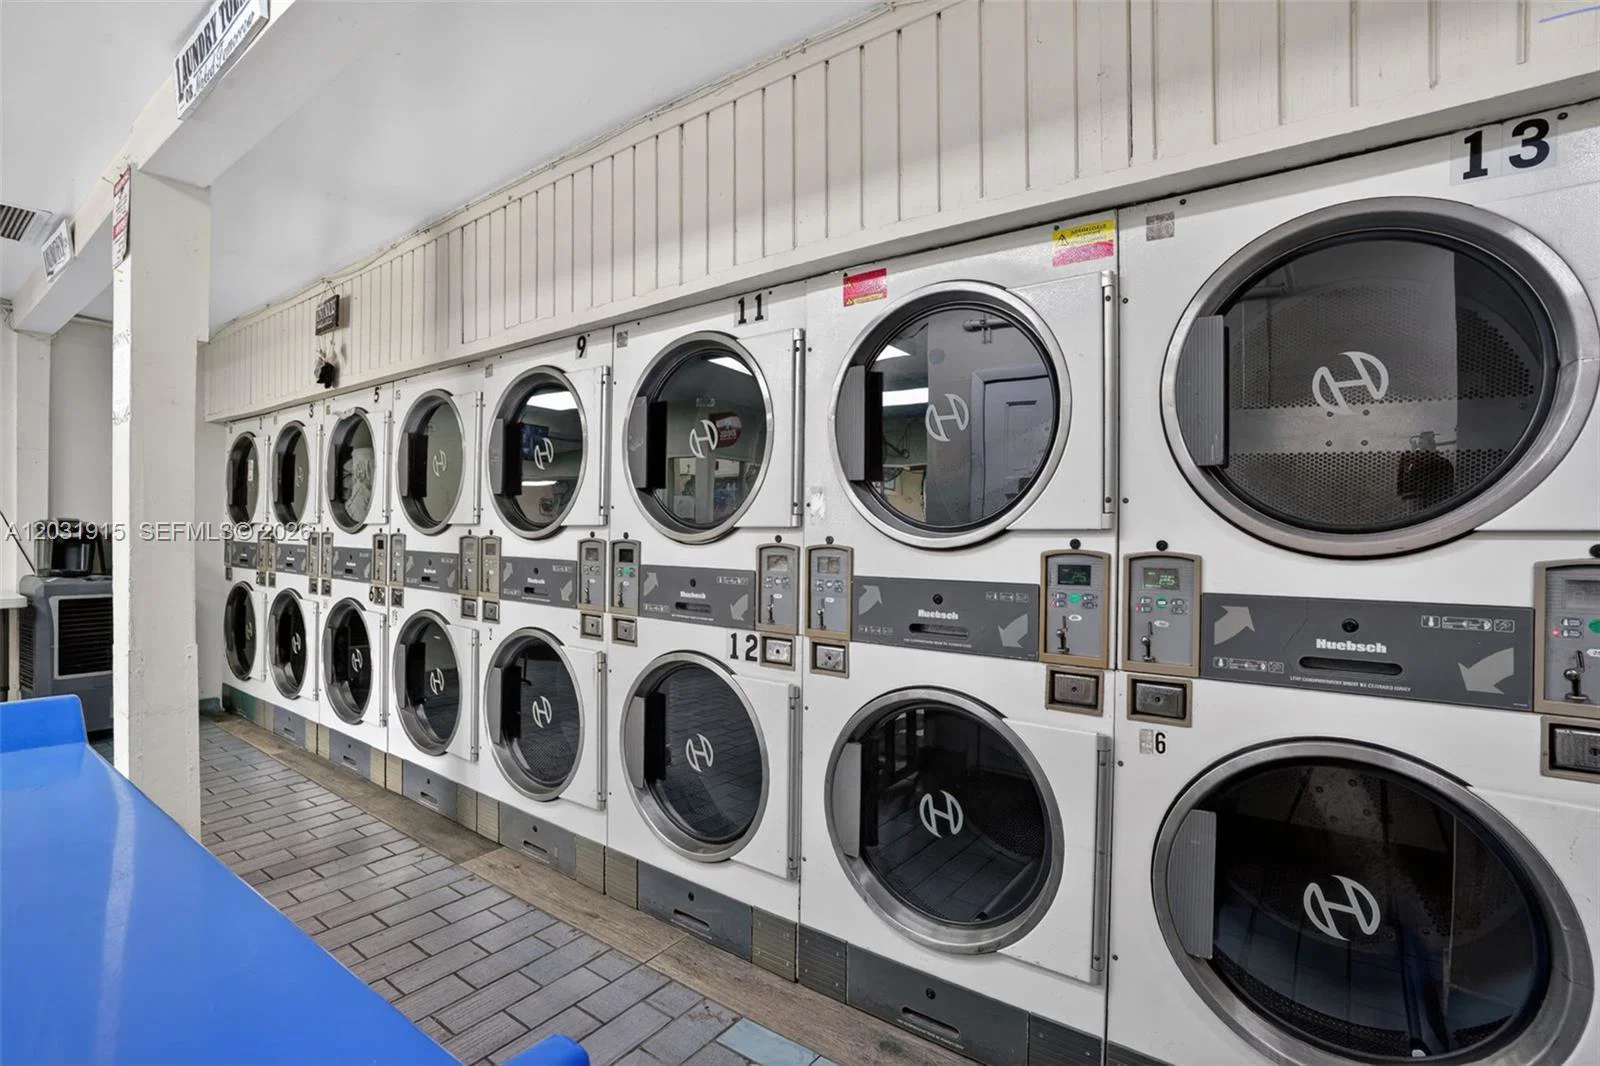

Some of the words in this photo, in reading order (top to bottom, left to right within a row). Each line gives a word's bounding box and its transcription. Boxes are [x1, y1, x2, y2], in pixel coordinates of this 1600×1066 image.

[175, 12, 218, 104] LAUNDRY
[1463, 118, 1550, 181] 13
[738, 293, 763, 324] 11
[577, 335, 586, 358] 9
[374, 386, 380, 403] 5
[918, 609, 959, 620] Huebsch
[730, 632, 758, 662] 12
[1315, 638, 1387, 654] Huebsch
[1155, 731, 1166, 754] 6
